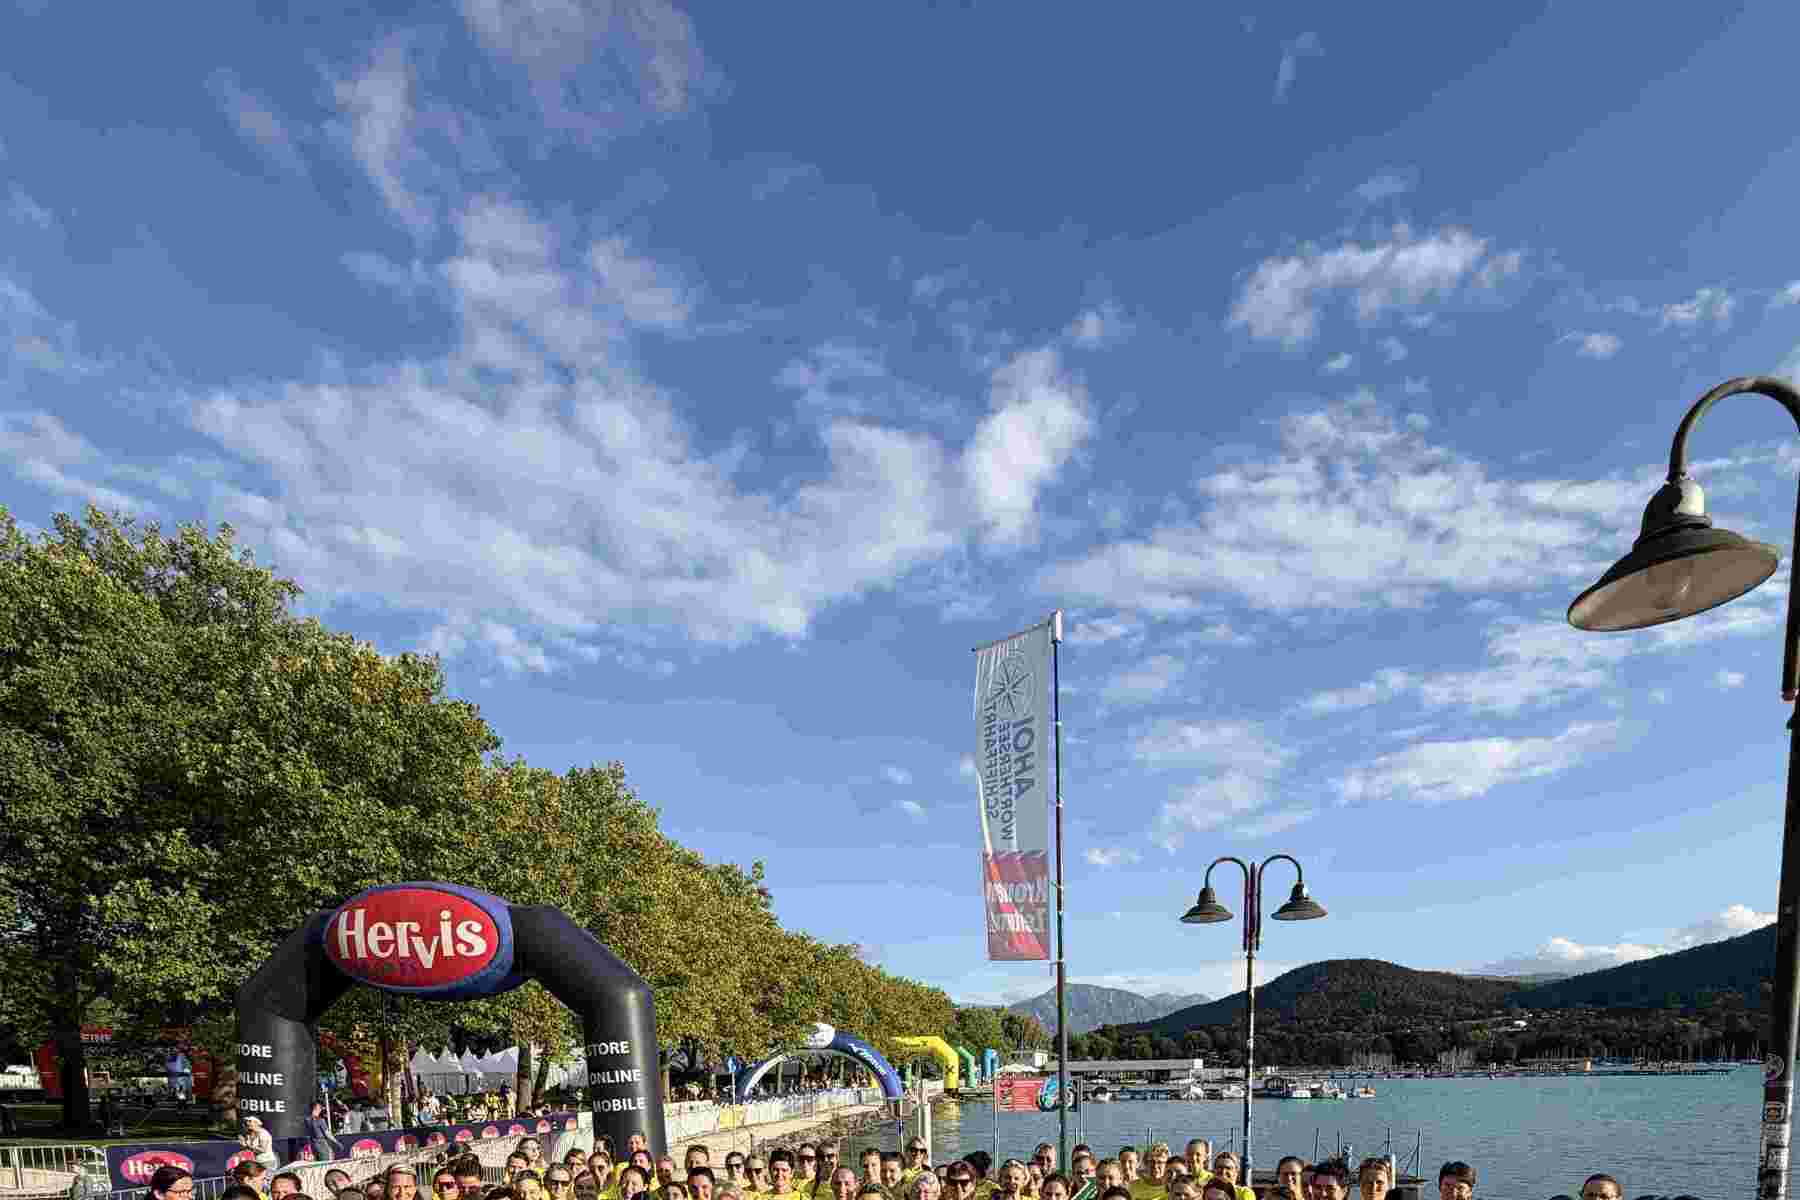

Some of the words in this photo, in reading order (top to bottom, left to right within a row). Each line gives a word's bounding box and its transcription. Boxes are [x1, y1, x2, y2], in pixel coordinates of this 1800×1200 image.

[337, 908, 488, 969] Hervis
[590, 1069, 642, 1085] ONLINE
[240, 1099, 287, 1113] OBILE
